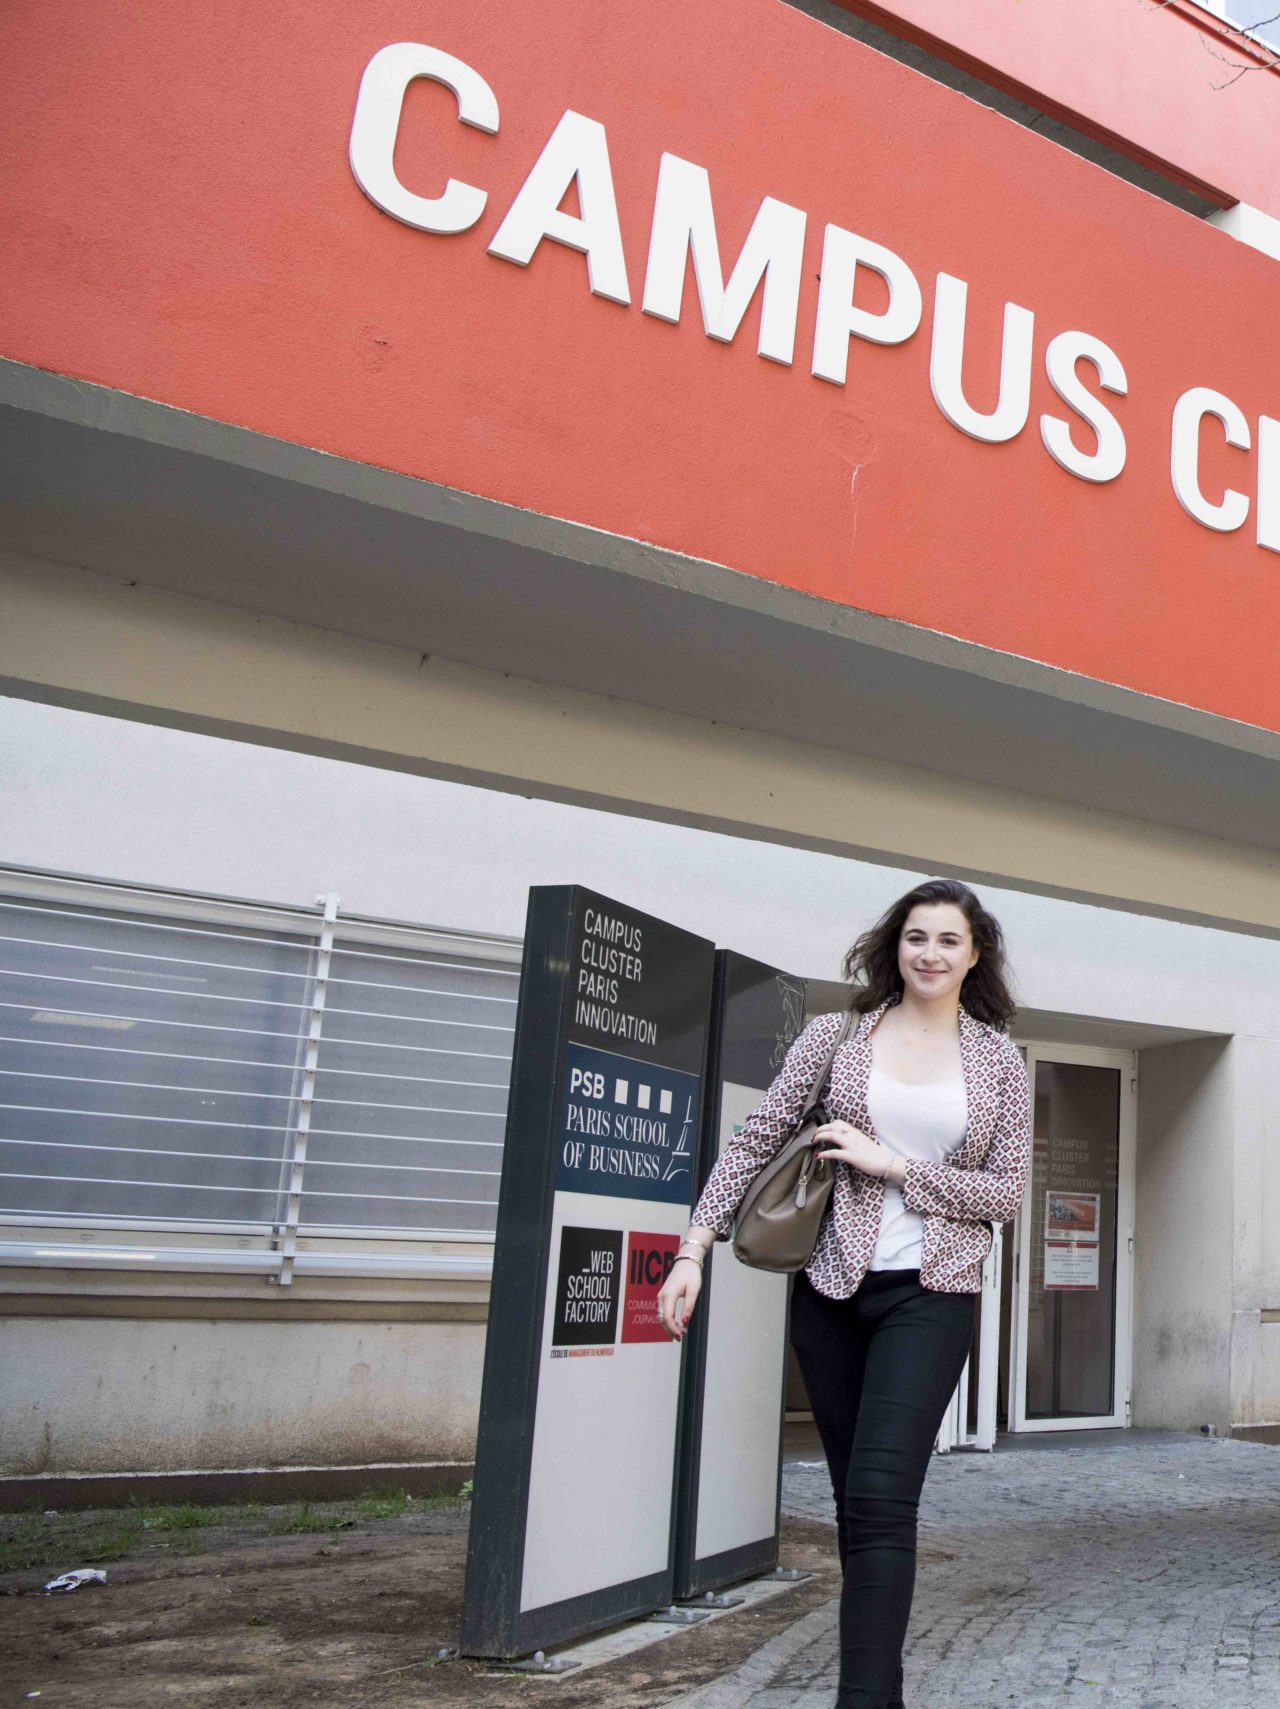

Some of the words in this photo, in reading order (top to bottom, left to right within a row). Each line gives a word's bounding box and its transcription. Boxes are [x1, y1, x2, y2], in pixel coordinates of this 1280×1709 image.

[349, 42, 1128, 483] CAMPUS
[584, 908, 642, 953] CAMPUS
[581, 939, 642, 982] CLUSTER
[578, 969, 618, 1004] PARIS
[575, 1000, 657, 1046] INNOVATION
[570, 1067, 605, 1099] PSB
[566, 1103, 611, 1135] PARIS
[614, 1115, 670, 1148] SCHOOL
[563, 1140, 585, 1168] OF
[589, 1146, 660, 1179] BUSINESS
[1051, 1151, 1090, 1163] CLUSTER
[1052, 1138, 1088, 1150] CAMPUS
[1051, 1163, 1076, 1174] PARIS
[1051, 1176, 1102, 1189] INNOVATION
[567, 1275, 612, 1300] SCHOOL
[564, 1300, 611, 1323] FACTORY
